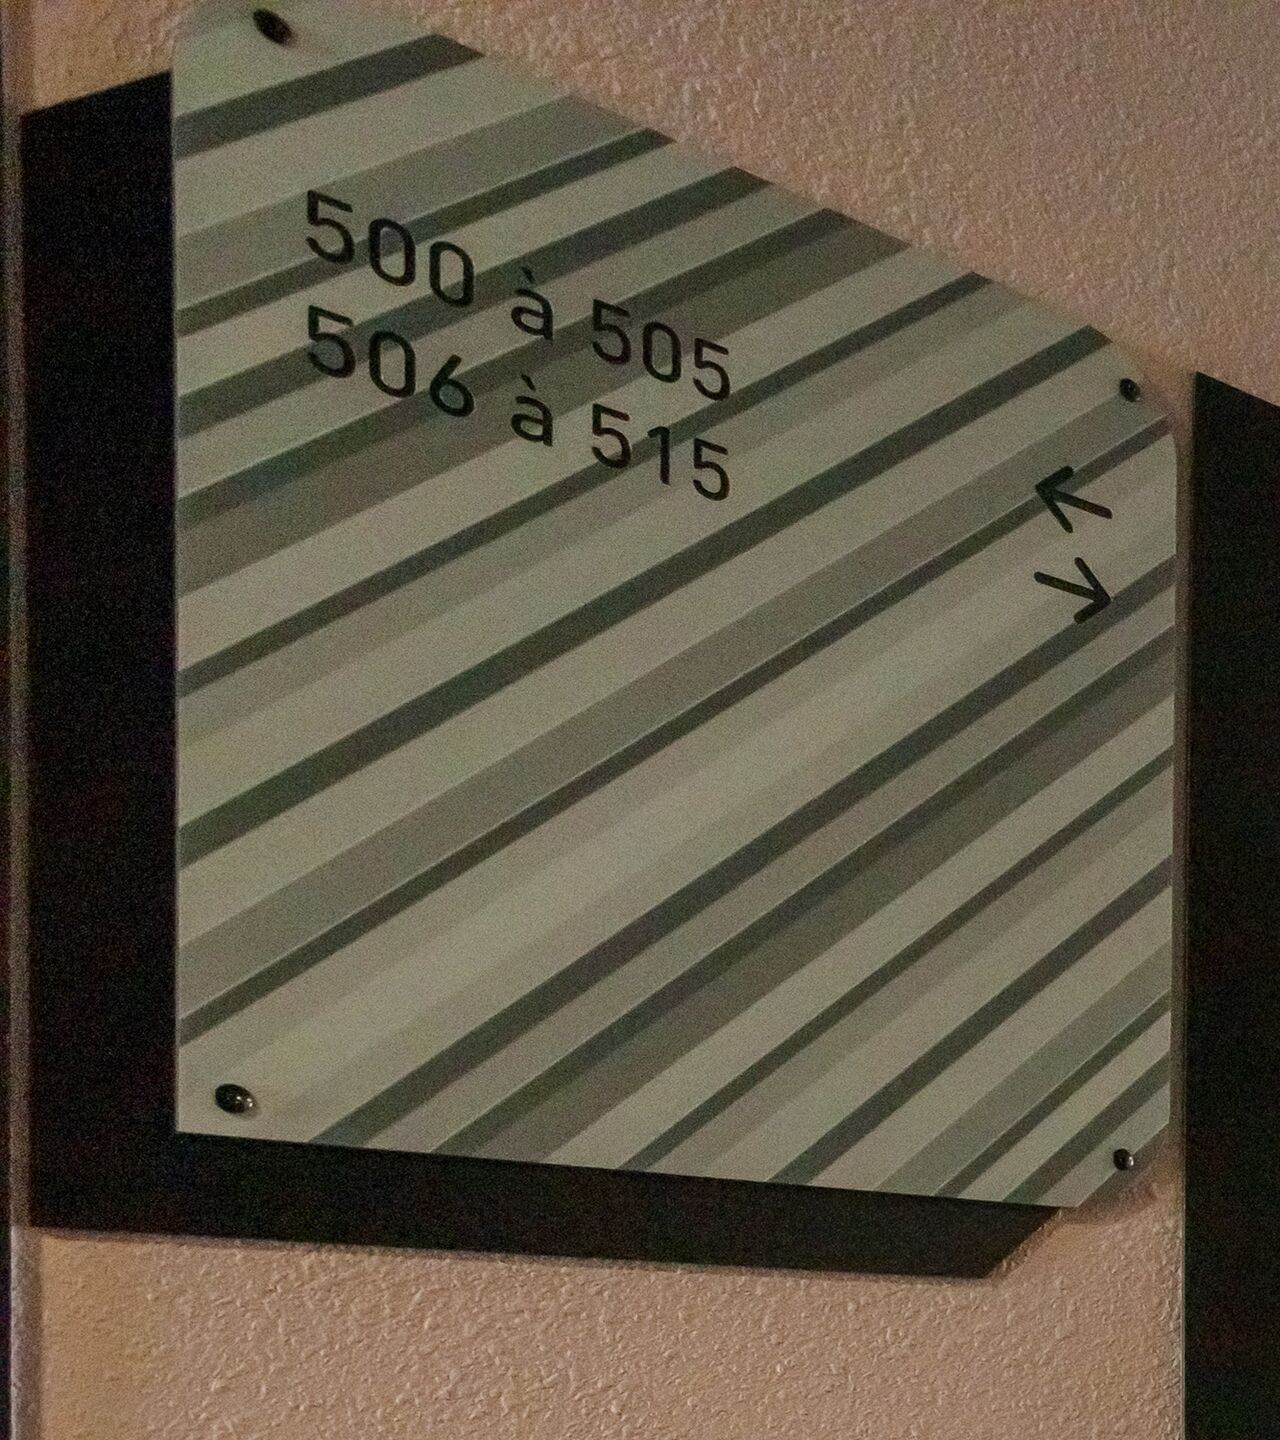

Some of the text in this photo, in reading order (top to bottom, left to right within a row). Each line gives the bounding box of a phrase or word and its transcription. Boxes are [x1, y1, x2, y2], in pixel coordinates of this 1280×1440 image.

[306, 189, 730, 400] 500 à 505
[307, 305, 730, 501] 506 à 515
